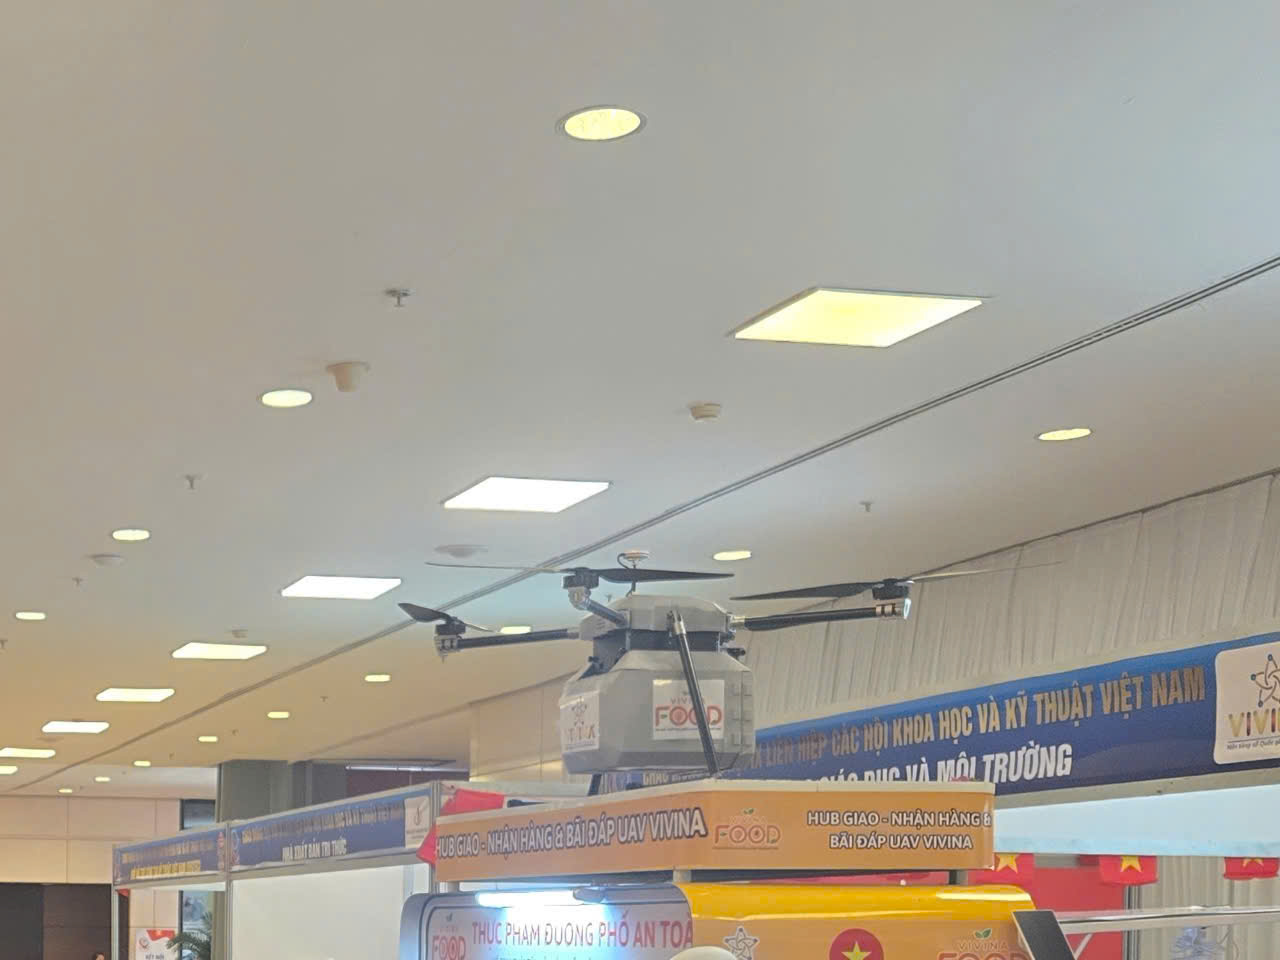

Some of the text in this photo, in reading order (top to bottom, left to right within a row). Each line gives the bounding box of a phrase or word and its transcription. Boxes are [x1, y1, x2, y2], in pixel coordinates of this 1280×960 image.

[863, 716, 888, 757] HỘI
[893, 712, 934, 748] KHOA
[939, 706, 973, 745] HỌC
[977, 695, 1000, 734] VÀ
[1005, 690, 1029, 730] KỸ
[1034, 681, 1094, 727] THUẬT
[1100, 671, 1144, 720] VIỆT
[1151, 666, 1205, 708] NAM
[1229, 707, 1280, 737] VIVI
[937, 751, 975, 783] MÔI
[982, 740, 1072, 784] TRƯỜNG
[436, 834, 455, 858] HUB
[457, 831, 480, 857] GIAO
[487, 824, 520, 861] NHẬN
[520, 820, 553, 852] HÀNG
[555, 828, 564, 849] &
[566, 814, 586, 848] BÃI
[588, 810, 616, 846] ĐÁP
[618, 812, 648, 843] UAV
[649, 806, 708, 840] VIVINA
[807, 811, 840, 826] HUB
[843, 811, 879, 826] GIAO
[891, 808, 935, 829] NHẬN
[938, 808, 981, 827] HÀNG
[983, 812, 992, 827] &
[715, 824, 781, 844] FOOD
[830, 832, 973, 849] BÃI ĐÁP UAV VIVINA
[598, 910, 630, 947] PHỐ
[633, 920, 656, 948] AN
[660, 913, 694, 948] TOÀ
[960, 942, 1008, 950] VIVINA
